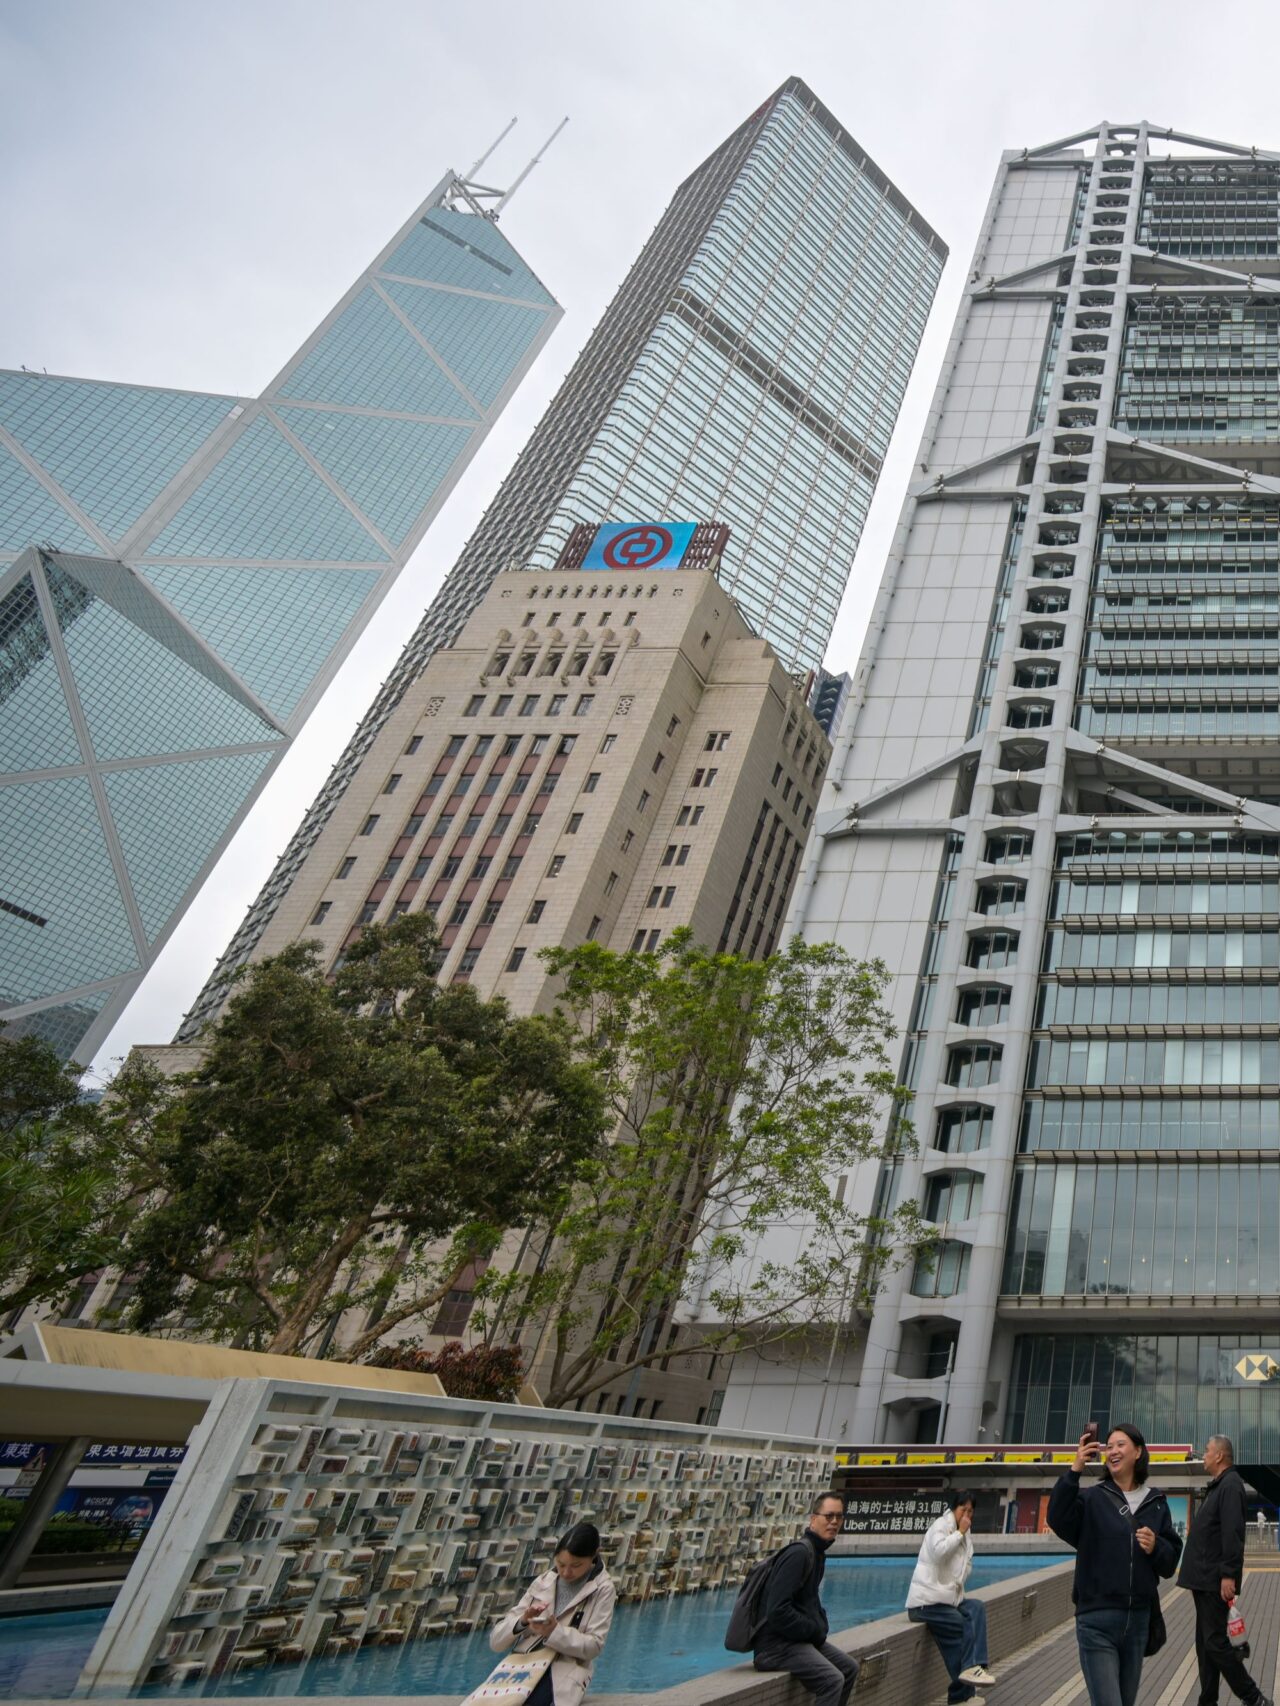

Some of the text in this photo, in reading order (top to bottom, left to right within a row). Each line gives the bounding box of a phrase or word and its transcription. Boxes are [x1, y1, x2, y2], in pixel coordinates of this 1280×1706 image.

[847, 1501, 916, 1514] 過海的士站得
[917, 1502, 929, 1513] 31
[844, 1520, 868, 1530] Uber
[870, 1520, 888, 1530] Taxi
